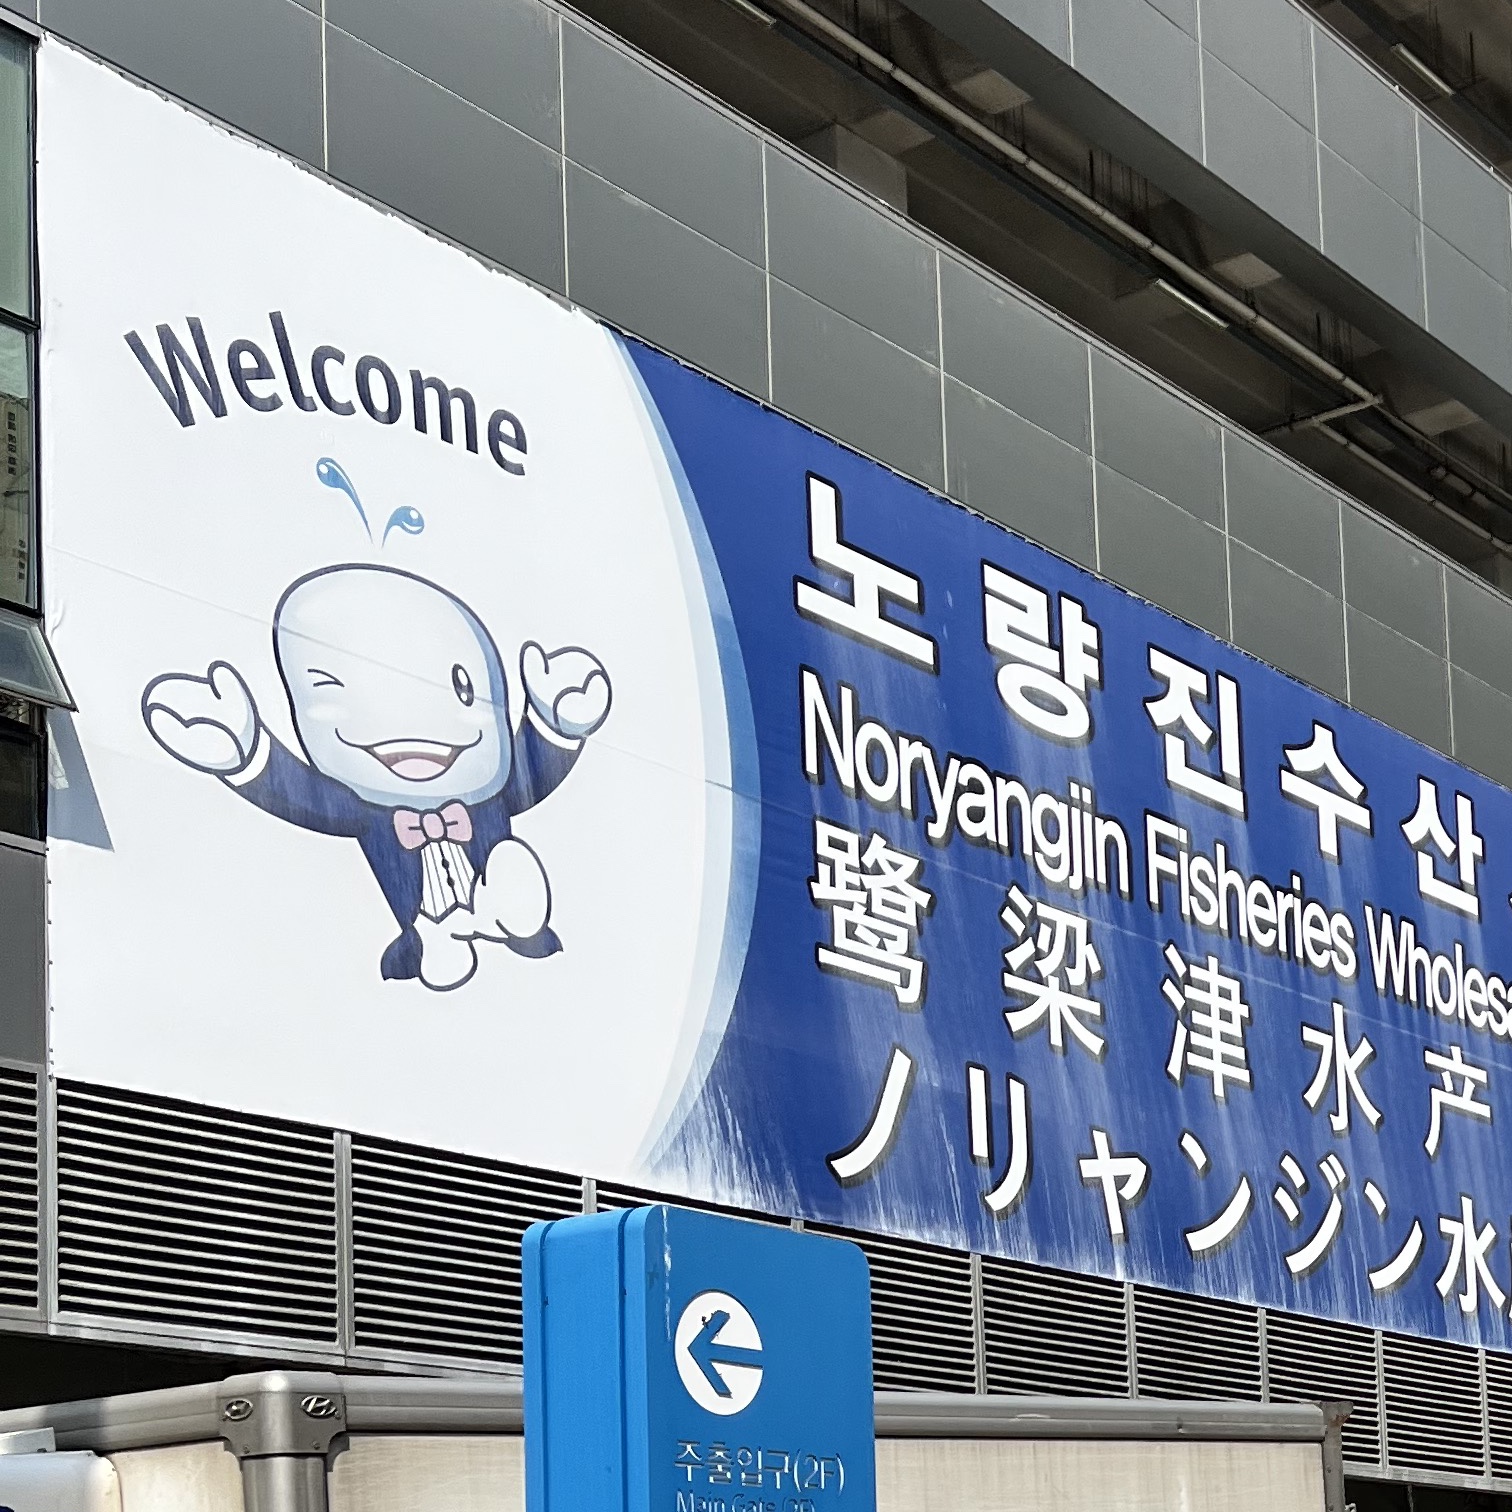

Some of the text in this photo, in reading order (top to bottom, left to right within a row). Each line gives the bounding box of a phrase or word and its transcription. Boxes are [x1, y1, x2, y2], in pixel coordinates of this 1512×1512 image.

[123, 310, 528, 477] Welcome
[801, 670, 1130, 893] Noryangjin
[1146, 814, 1357, 979] Fisheries
[674, 1438, 845, 1498] 주출입구(2F)
